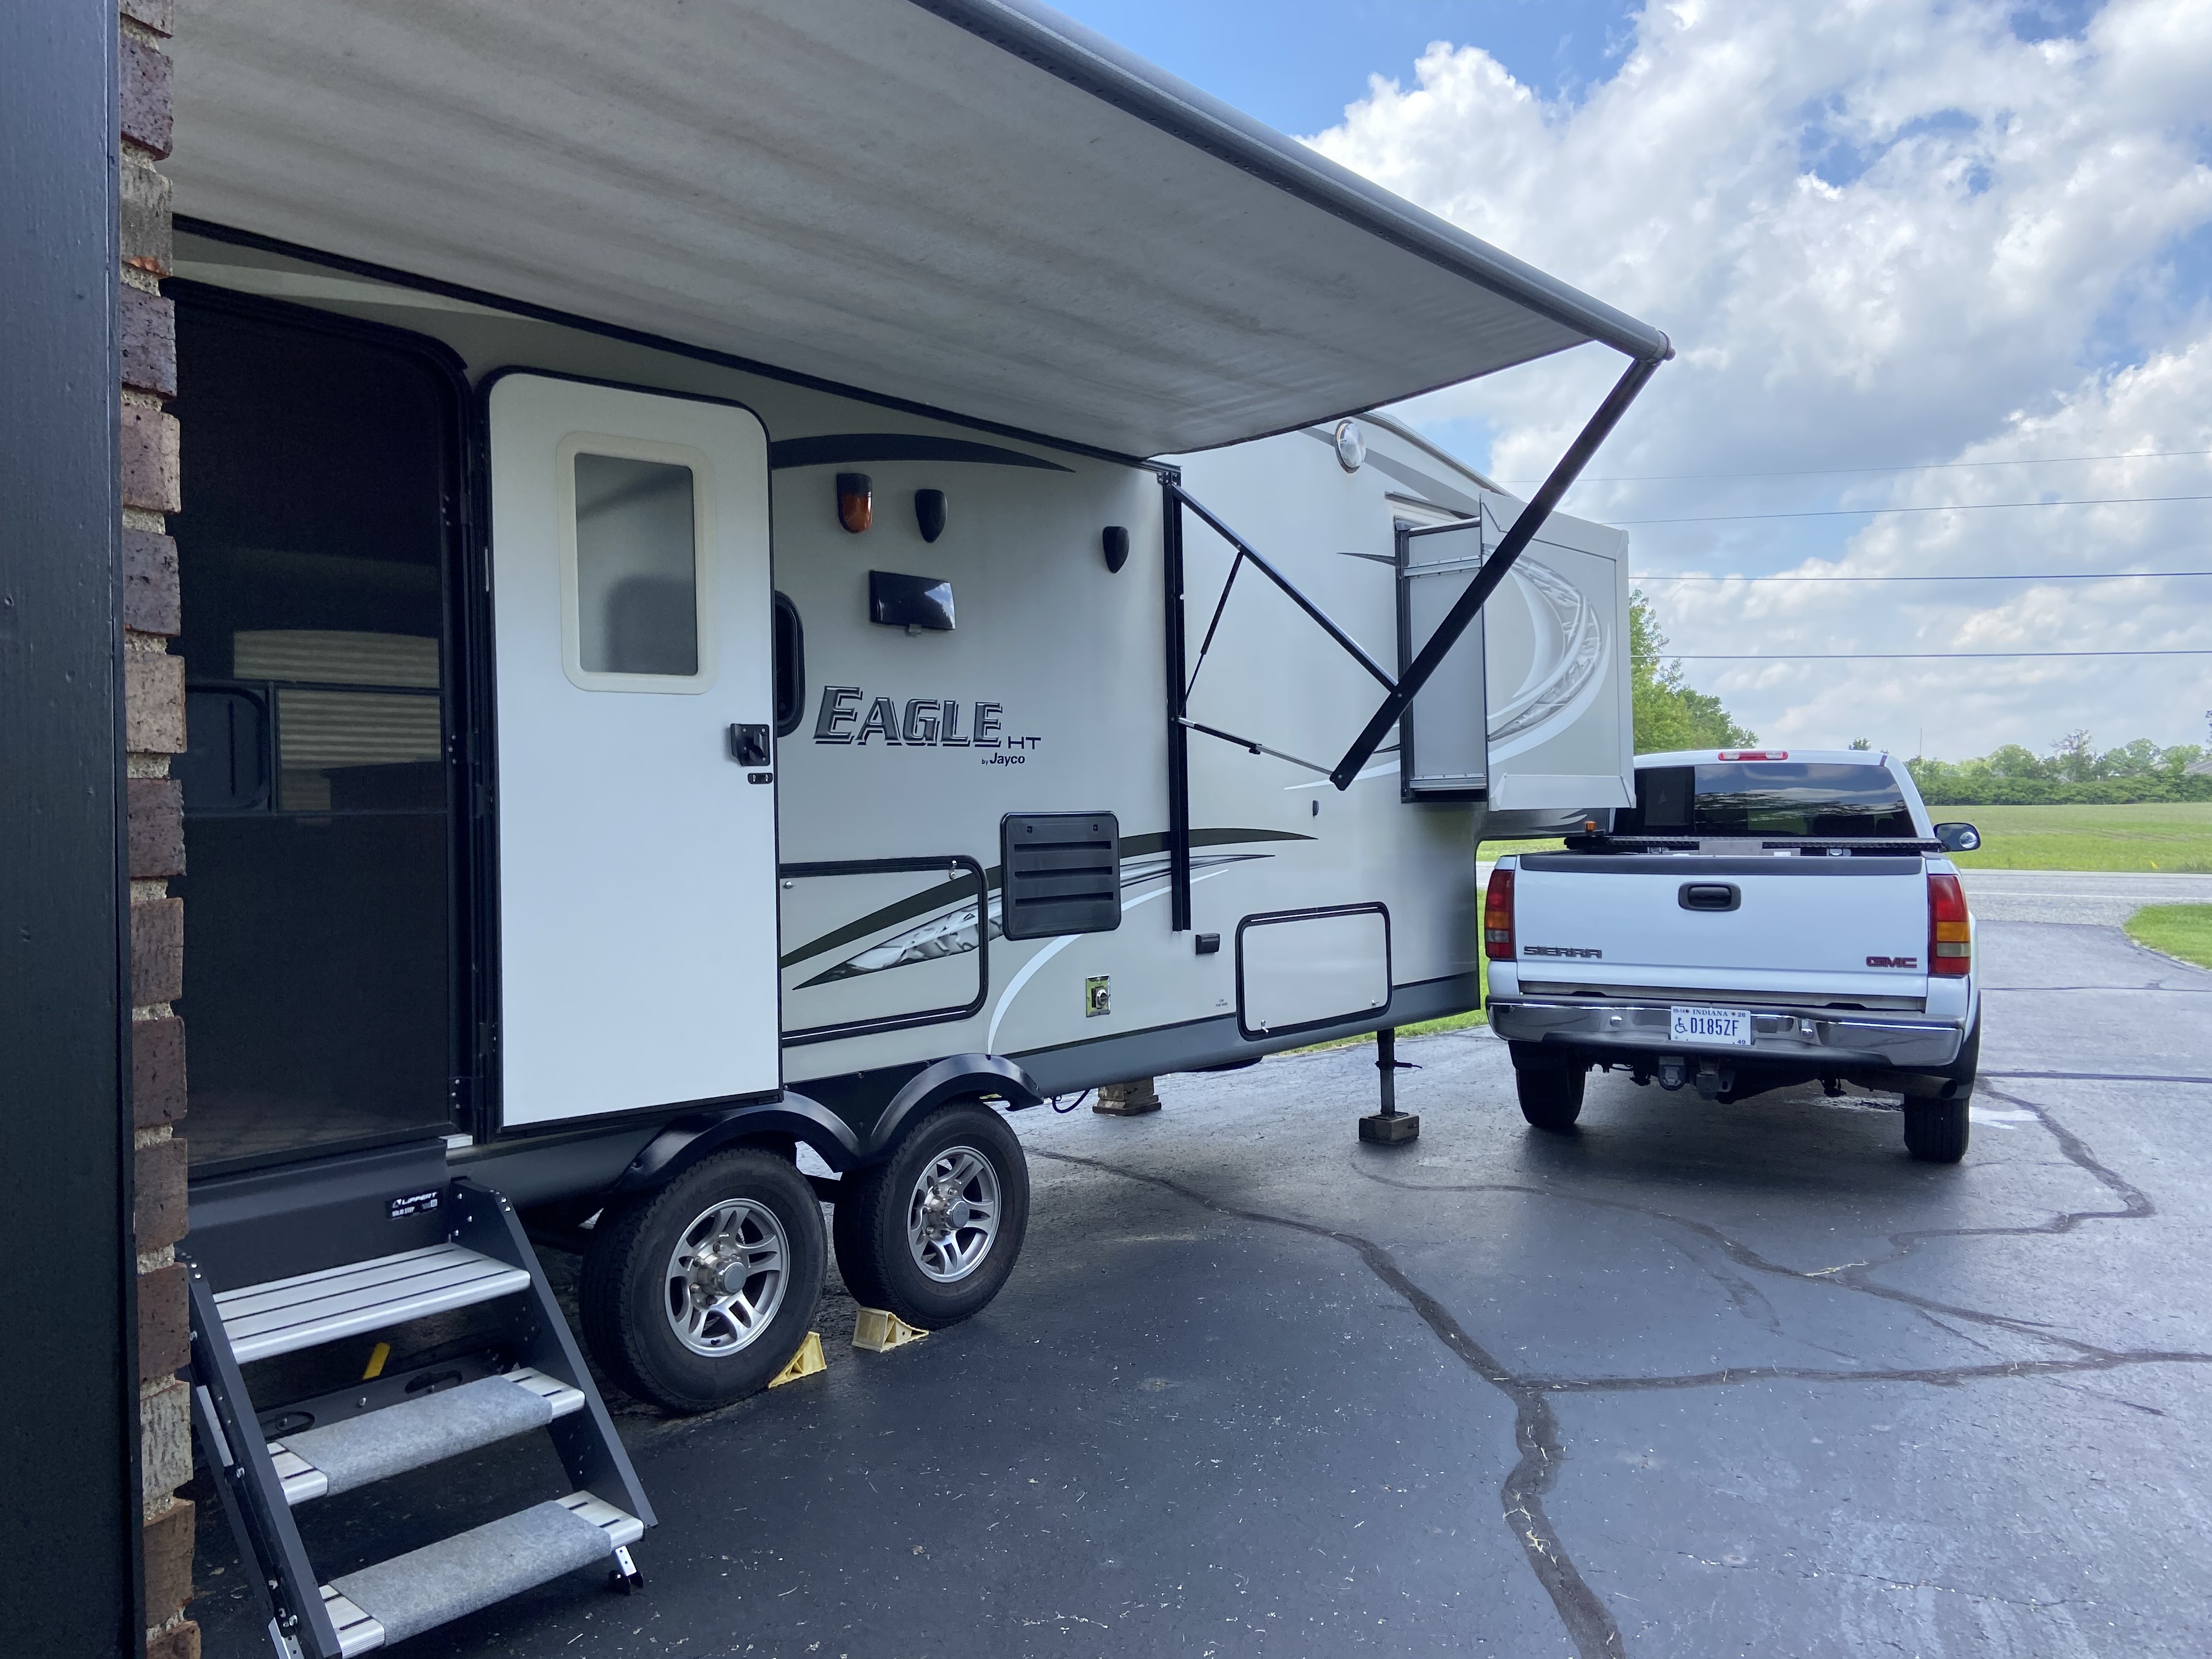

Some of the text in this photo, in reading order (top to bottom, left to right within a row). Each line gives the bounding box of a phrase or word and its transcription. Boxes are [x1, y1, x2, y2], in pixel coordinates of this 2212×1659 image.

[812, 685, 1041, 749] EAGLE HT
[990, 752, 1025, 766] Jayco
[1524, 945, 1602, 958] SIERRA
[1866, 956, 1917, 968] GMC
[1691, 1017, 1739, 1036] D185ZF
